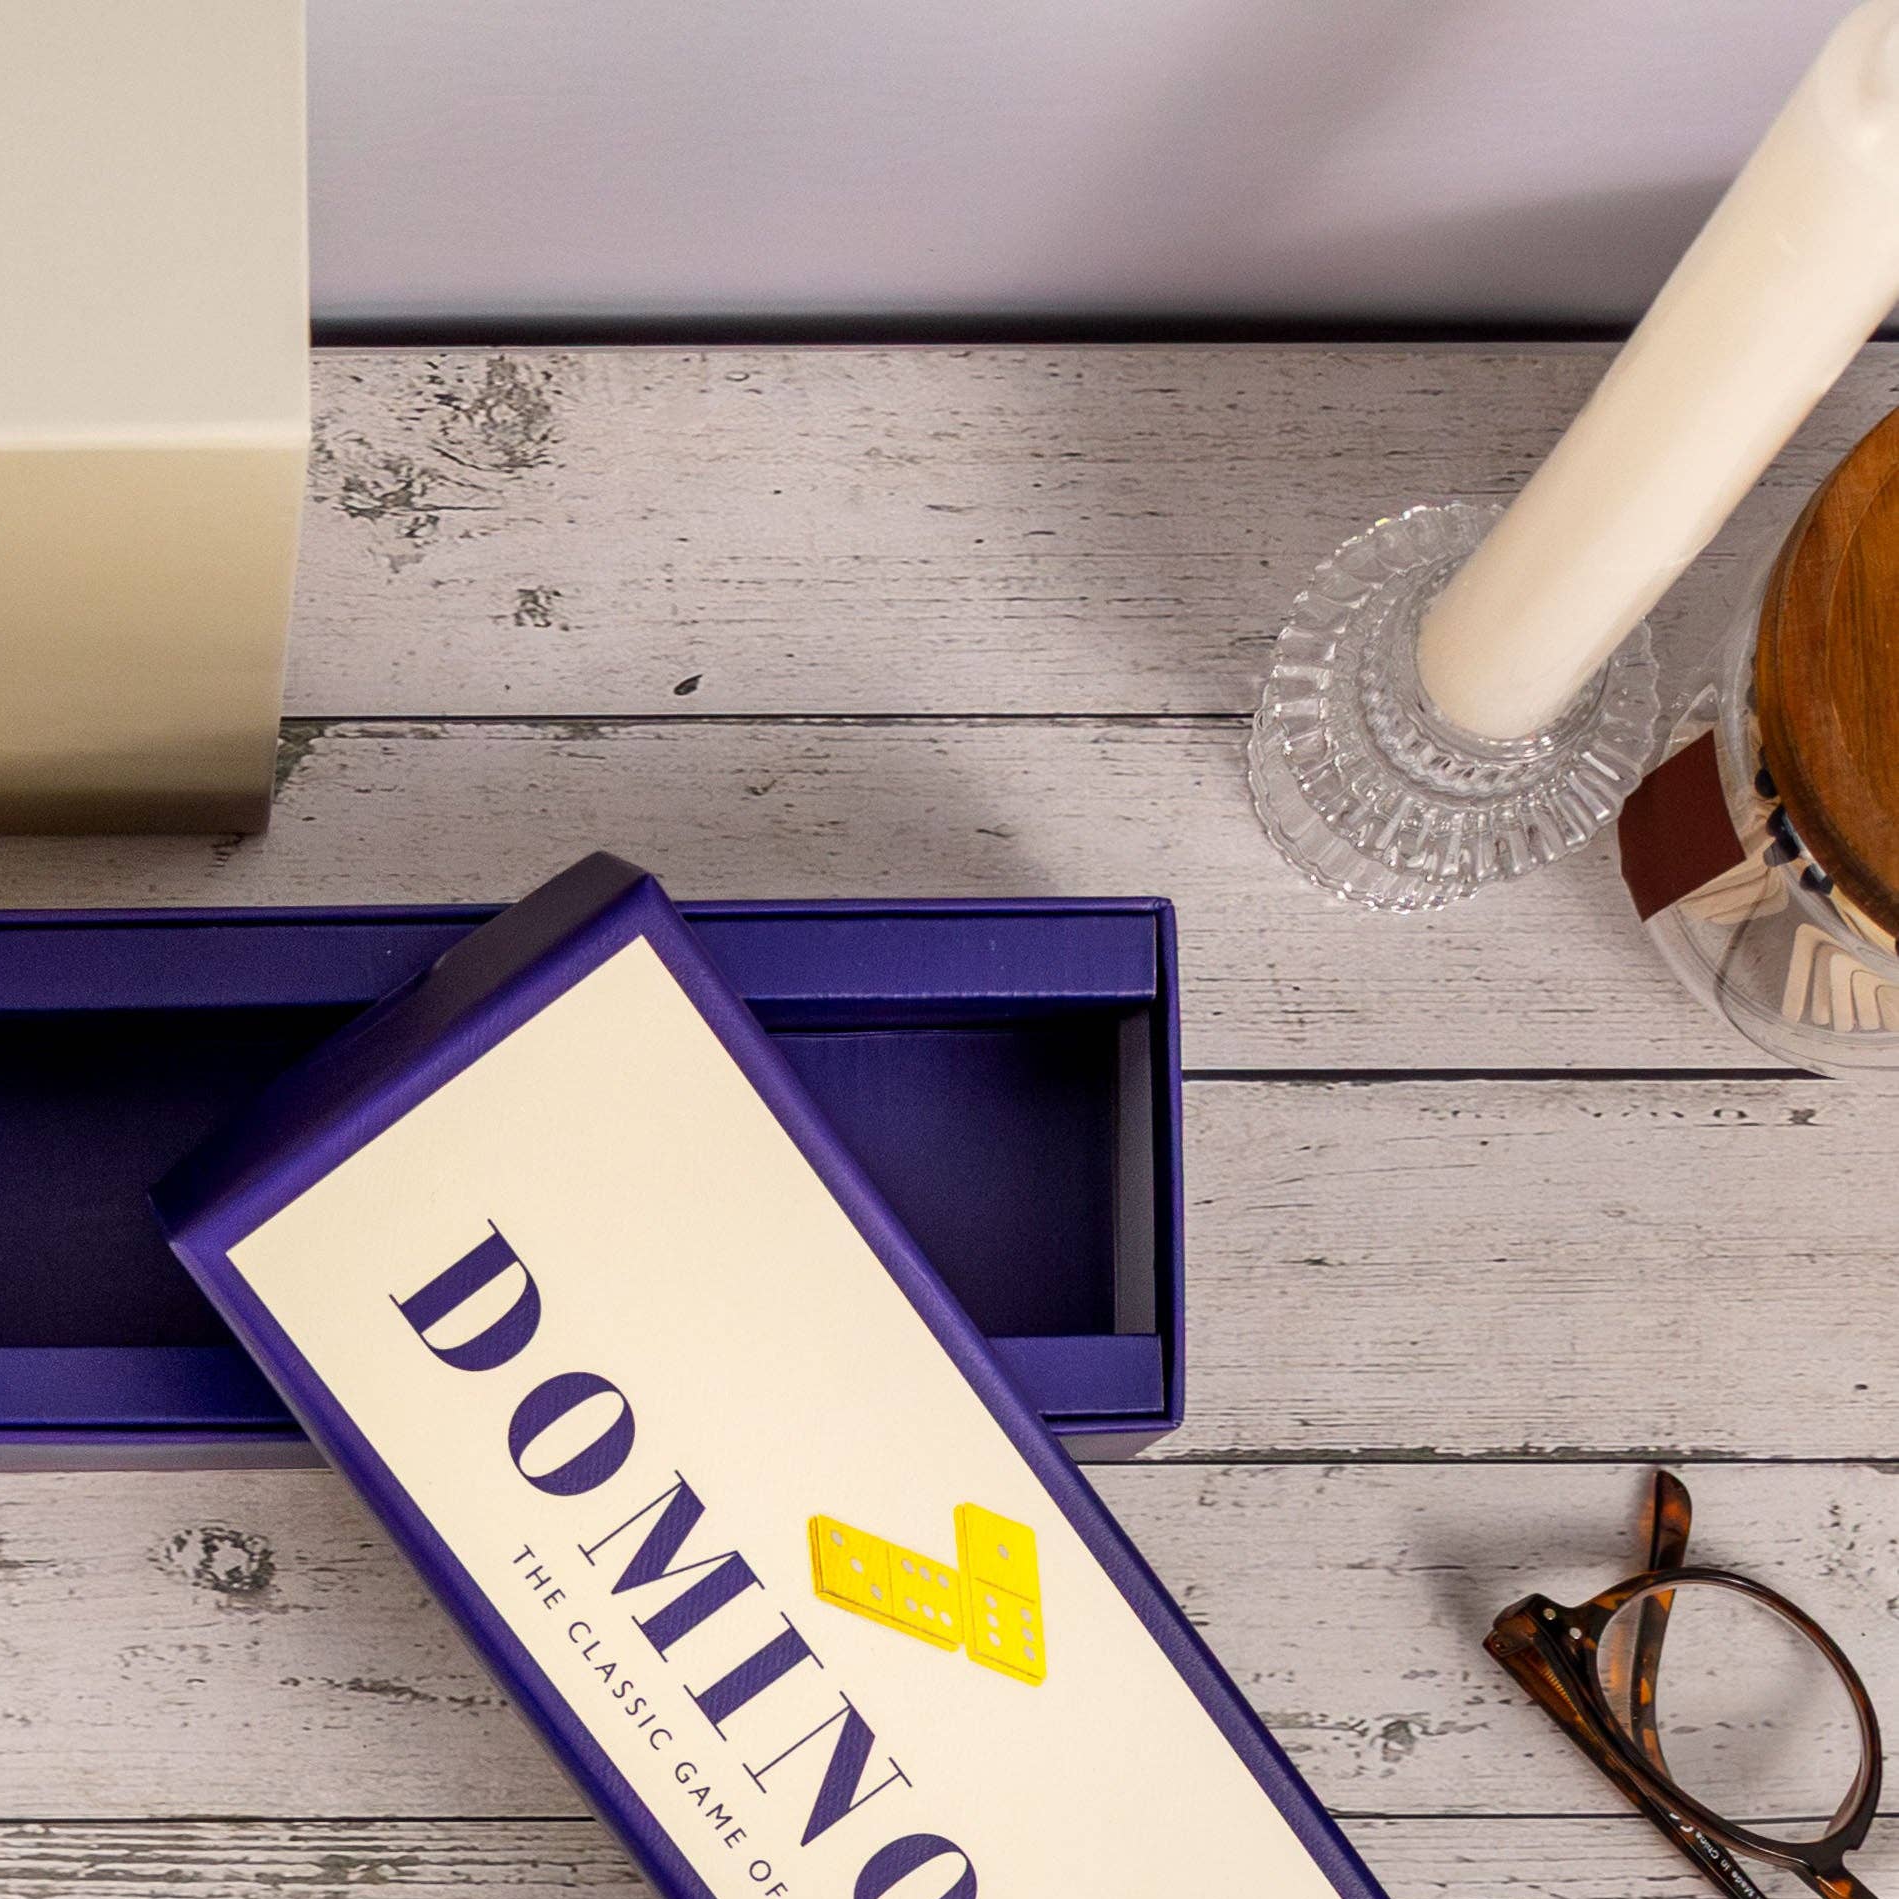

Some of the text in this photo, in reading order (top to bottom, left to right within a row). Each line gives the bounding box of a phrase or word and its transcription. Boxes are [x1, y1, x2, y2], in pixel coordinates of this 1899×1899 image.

[512, 1544, 564, 1611] THE
[568, 1621, 672, 1751] CLASSIC
[674, 1761, 748, 1848] GAME
[749, 1859, 788, 1897] OF
[1695, 1832, 1720, 1860] China
[1731, 1871, 1756, 1898] Made
